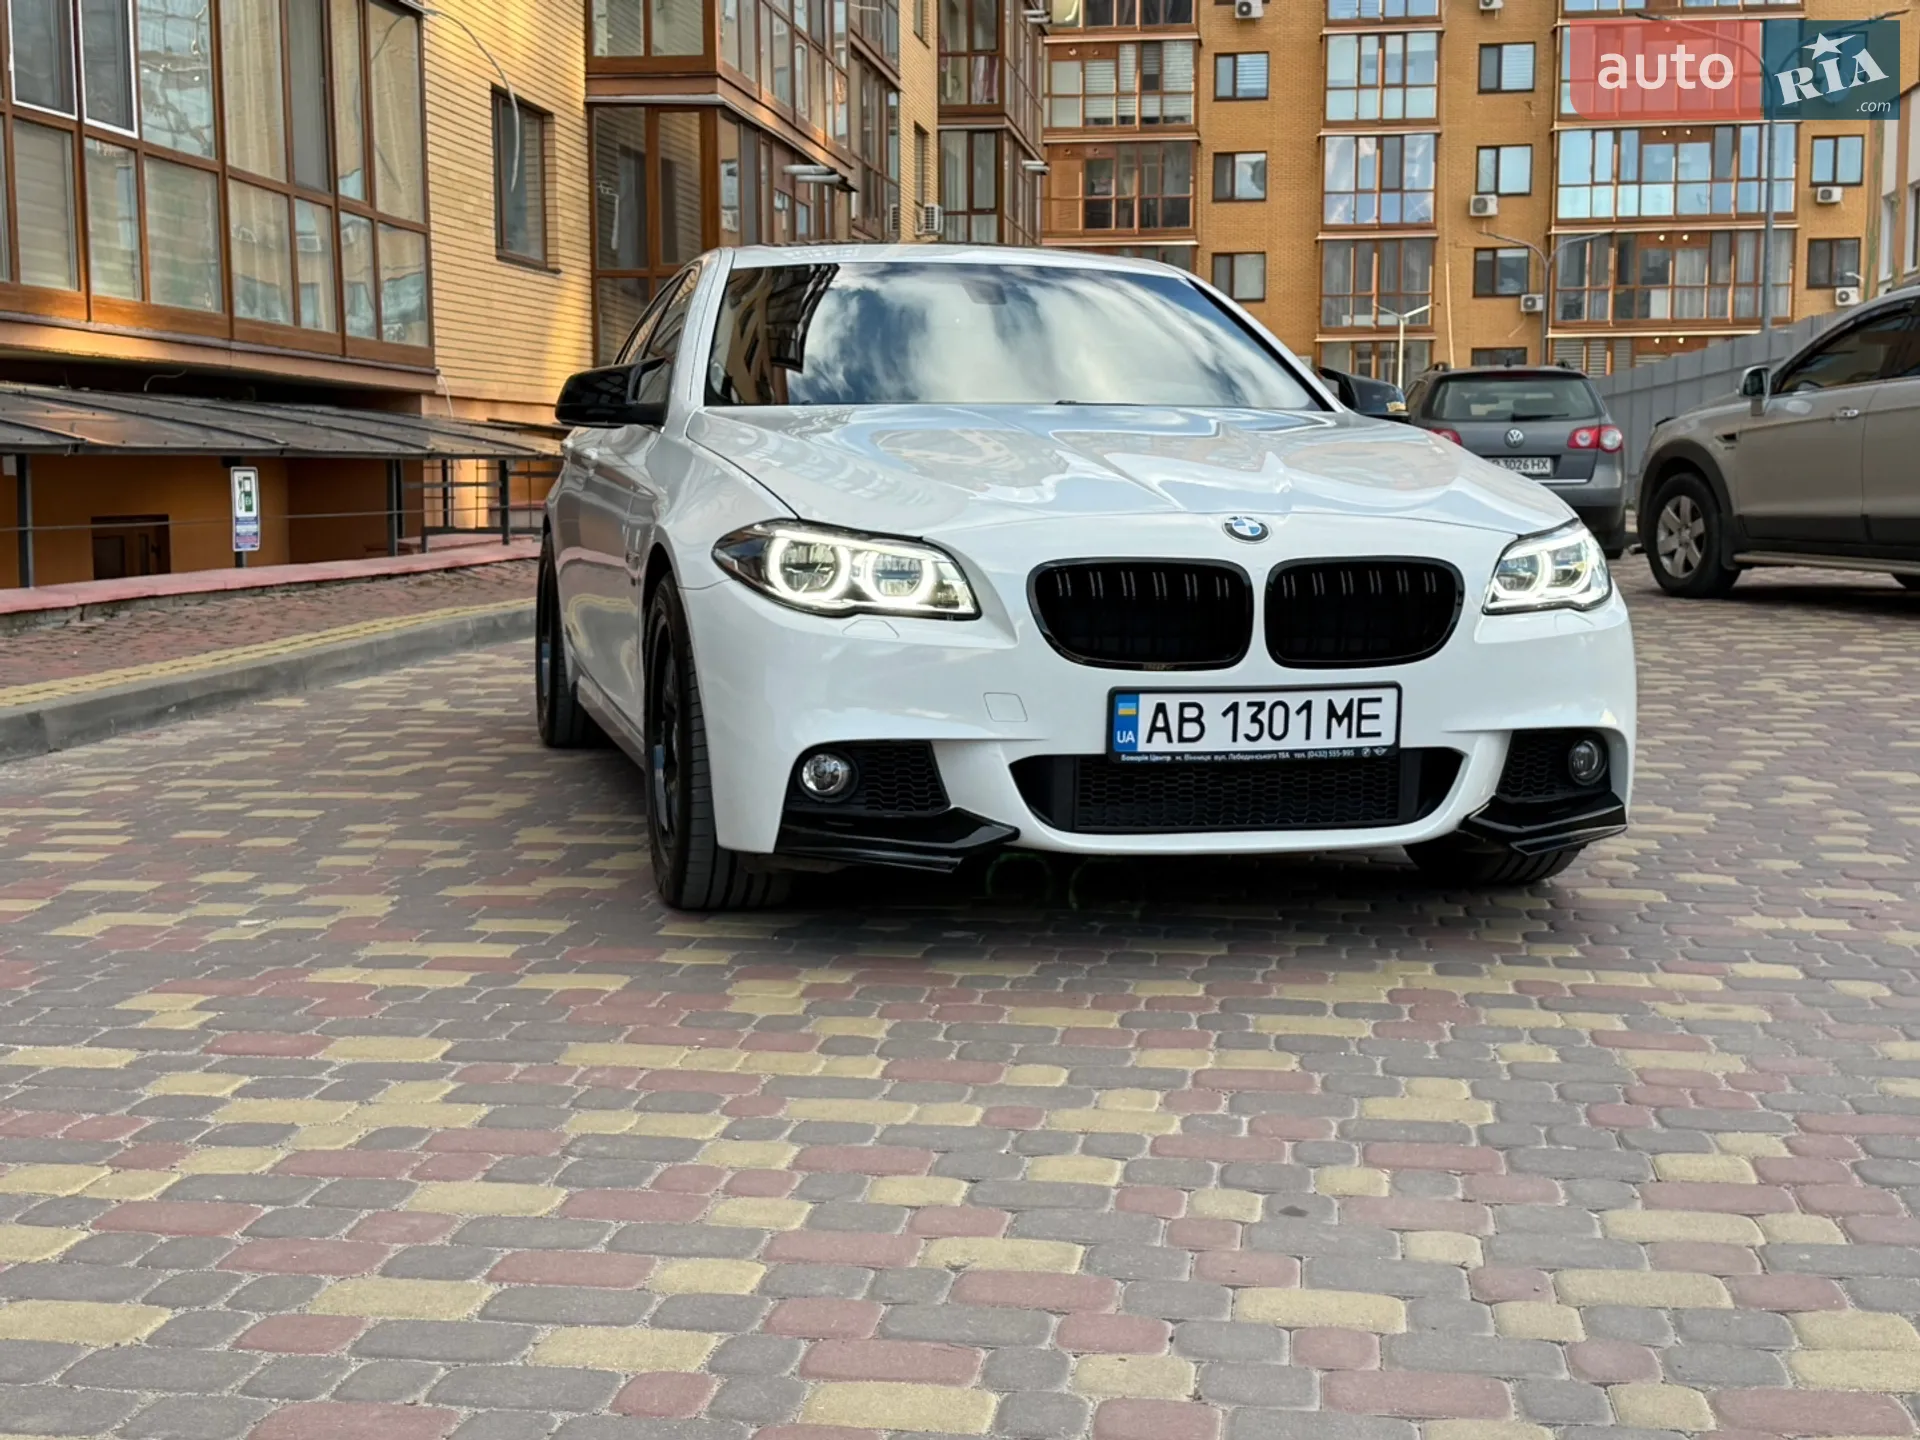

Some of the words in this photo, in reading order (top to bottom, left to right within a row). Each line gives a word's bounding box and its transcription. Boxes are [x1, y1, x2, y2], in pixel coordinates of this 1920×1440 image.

[1146, 702, 1206, 744] AB
[1221, 699, 1313, 743] 1301
[1326, 697, 1382, 740] ME
[1117, 730, 1135, 744] UA
